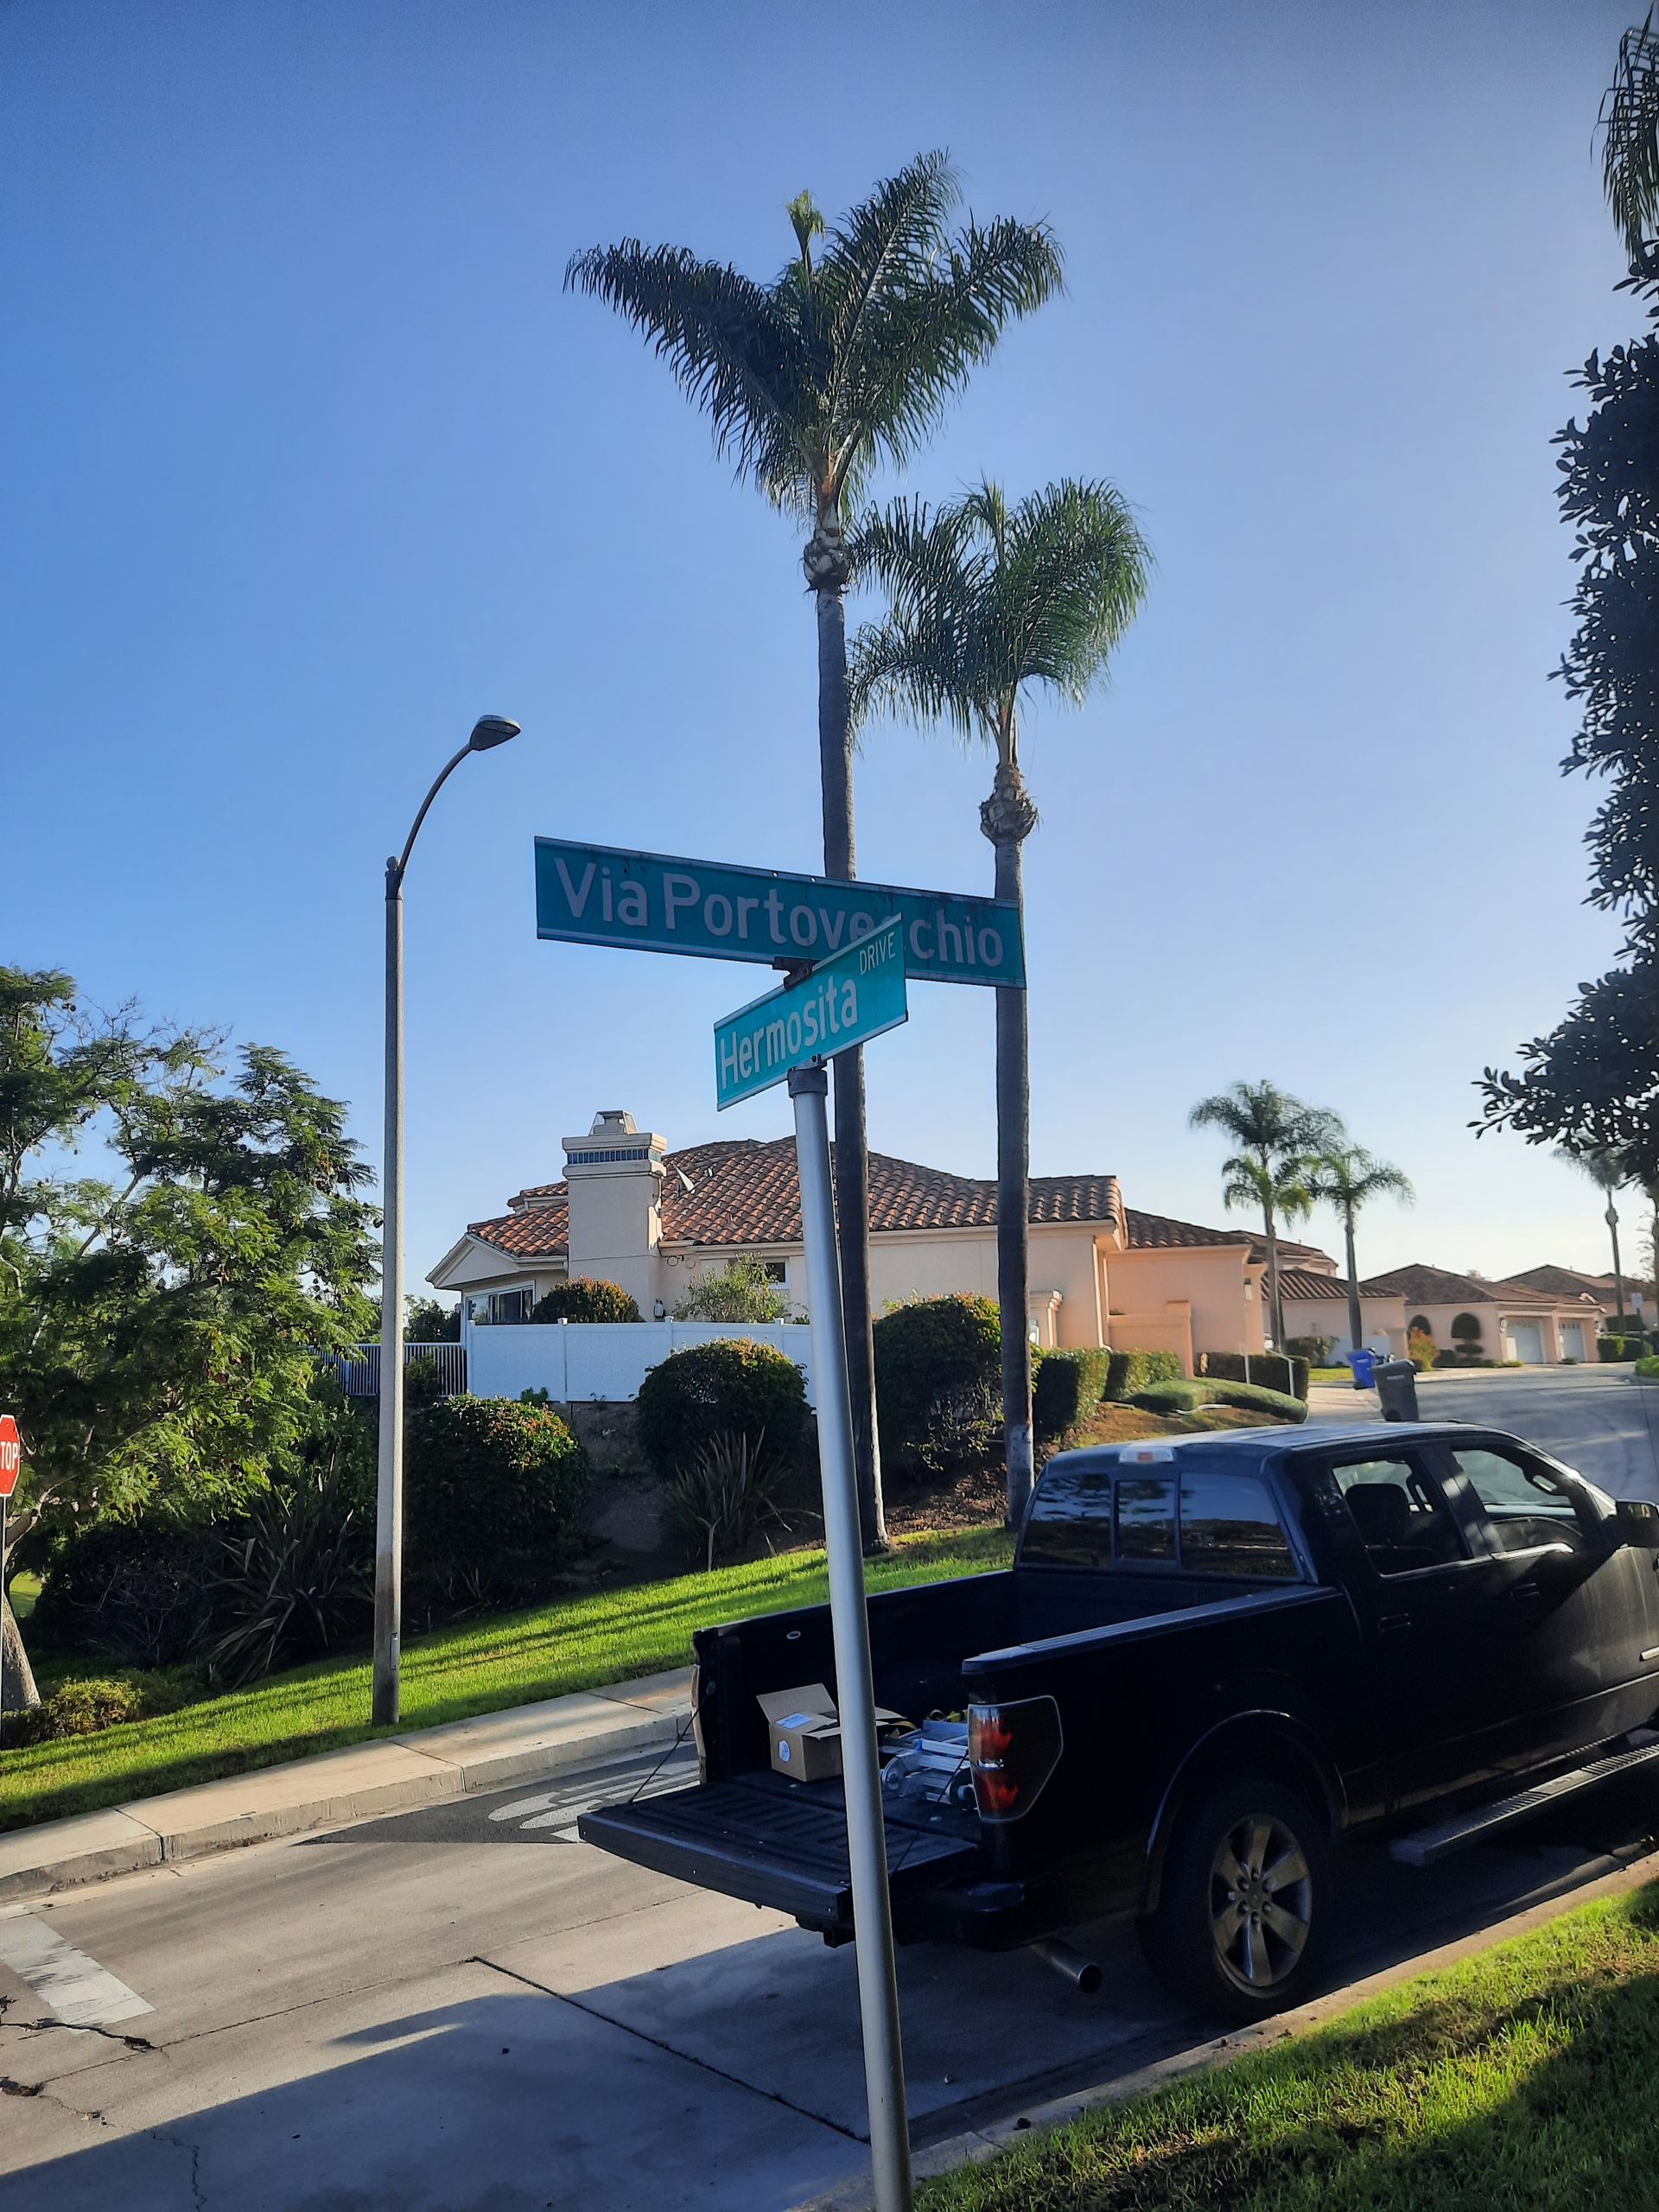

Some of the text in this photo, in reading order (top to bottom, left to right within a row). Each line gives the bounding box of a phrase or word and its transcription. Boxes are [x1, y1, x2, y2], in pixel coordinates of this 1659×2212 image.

[554, 857, 1003, 968] Via Portovechio
[720, 931, 896, 1090] Hermosita DRIVE
[0, 1440, 18, 1471] TOP
